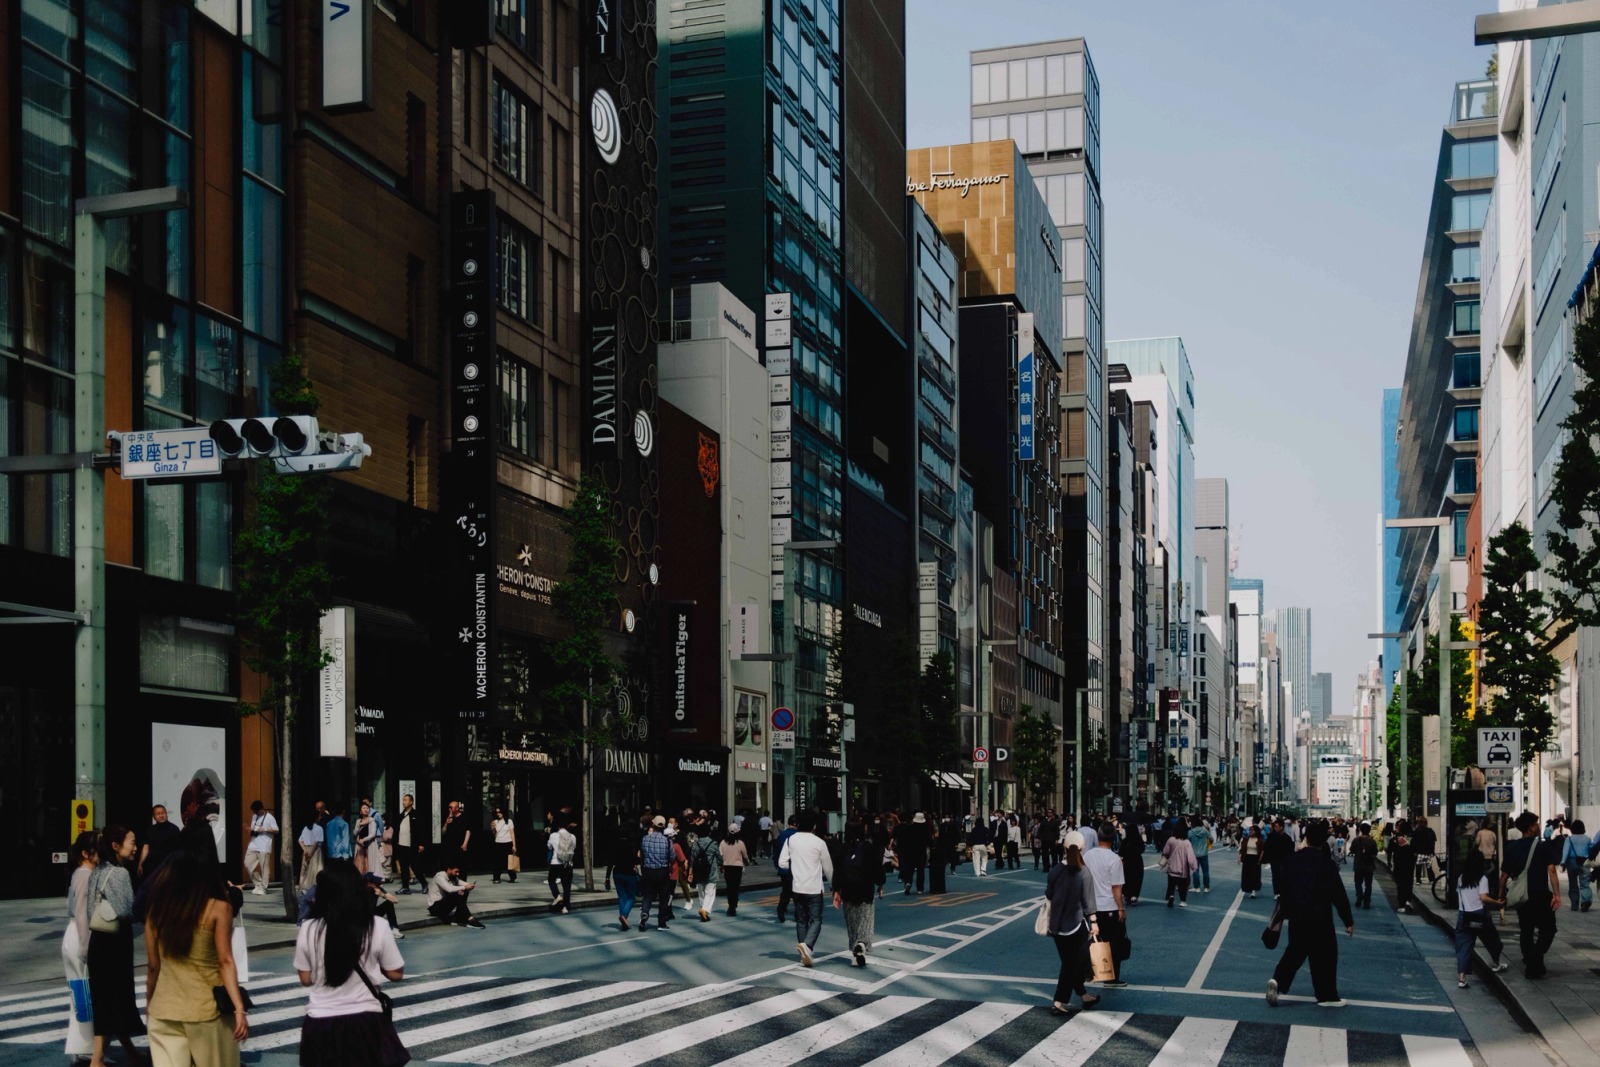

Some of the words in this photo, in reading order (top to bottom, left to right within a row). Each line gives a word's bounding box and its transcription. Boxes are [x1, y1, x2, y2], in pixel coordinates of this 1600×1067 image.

[930, 172, 1009, 198] Ferragamo
[592, 325, 616, 444] DAMIANI
[1020, 371, 1032, 447] 名鉄観光
[128, 432, 154, 443] 中央区
[128, 439, 214, 463] 銀座七丁目
[154, 462, 178, 473] Ginza
[182, 461, 188, 471] 7
[475, 573, 487, 639] CONSTANTIN
[476, 642, 487, 699] VACHERON
[674, 613, 689, 721] OnitsukaTiger
[1483, 732, 1516, 741] TAXI
[604, 750, 648, 774] DAMIANI
[996, 748, 1009, 761] D
[678, 758, 721, 776] OnitsukaTiger
